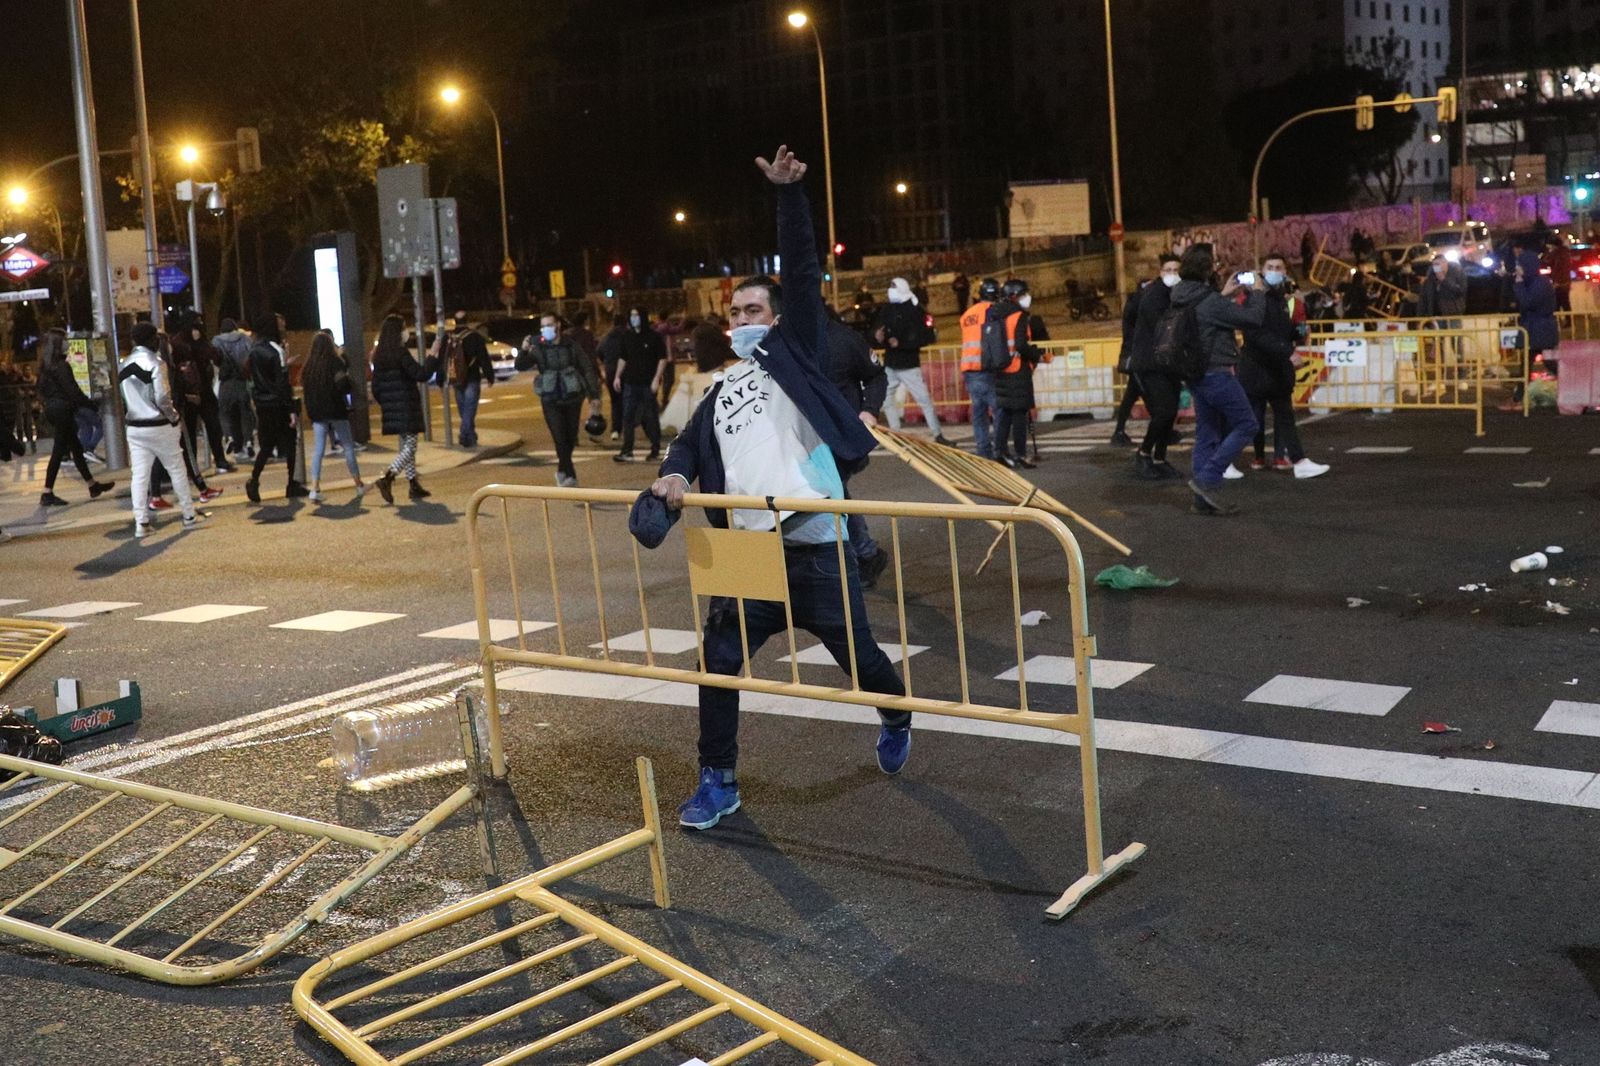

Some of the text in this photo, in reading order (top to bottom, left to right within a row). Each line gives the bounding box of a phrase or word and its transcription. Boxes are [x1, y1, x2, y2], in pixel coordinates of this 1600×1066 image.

[4, 260, 32, 271] Metro
[1327, 350, 1355, 363] FCC
[721, 380, 759, 411] NYC
